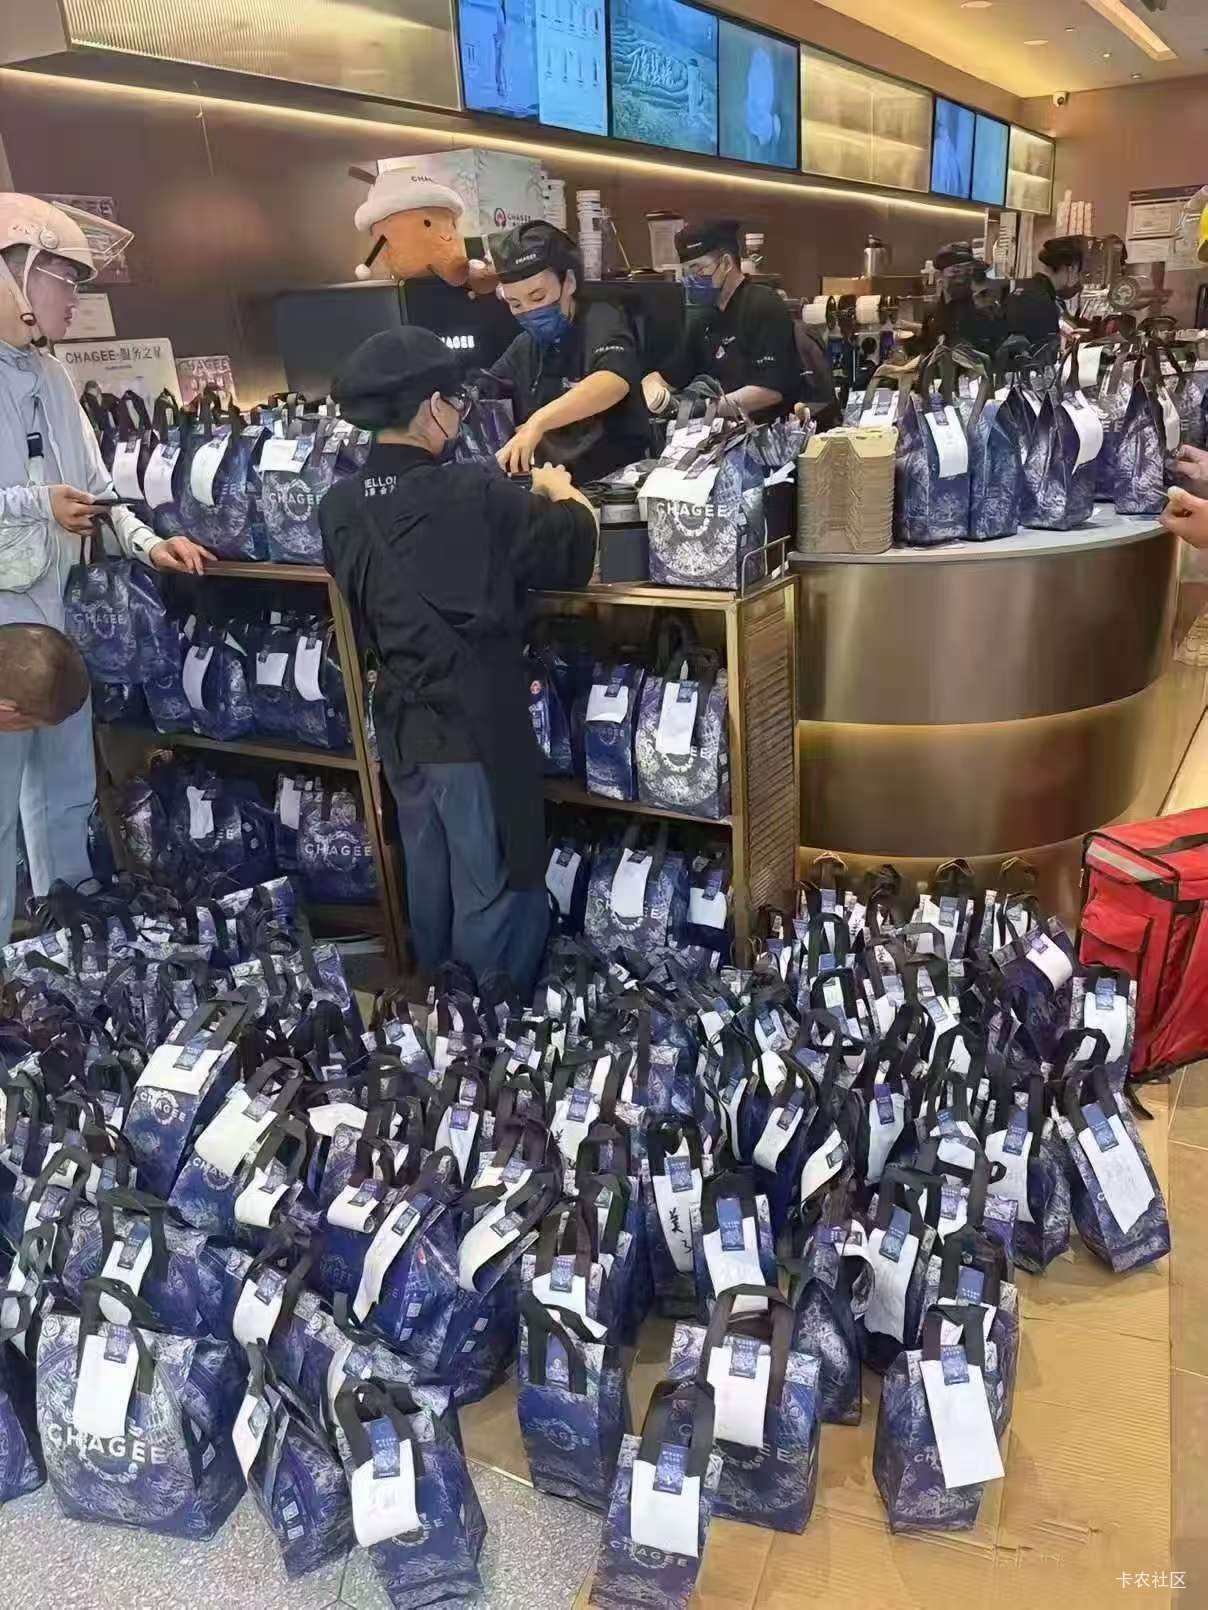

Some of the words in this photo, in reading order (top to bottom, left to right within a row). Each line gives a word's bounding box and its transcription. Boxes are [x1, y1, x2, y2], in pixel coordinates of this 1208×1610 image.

[656, 502, 729, 517] CHAGEE
[304, 843, 372, 857] CHAGEE
[48, 1422, 168, 1464] CHAGEE
